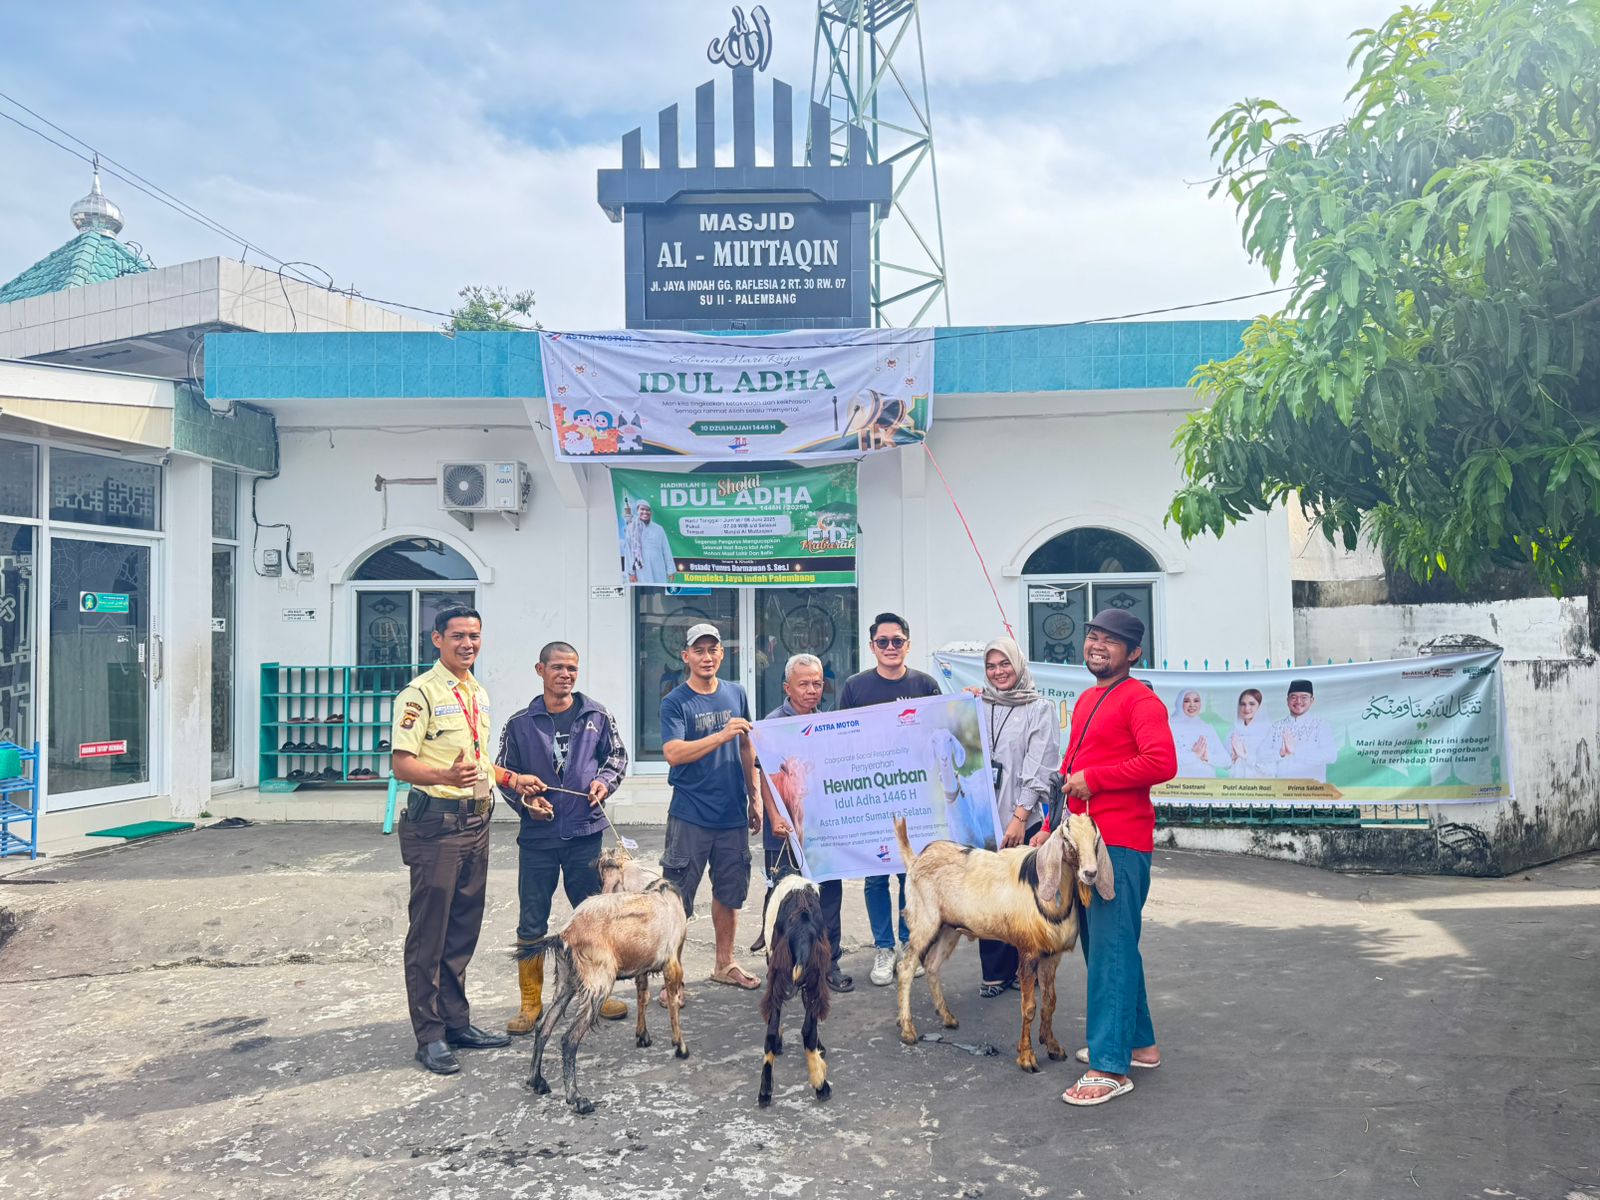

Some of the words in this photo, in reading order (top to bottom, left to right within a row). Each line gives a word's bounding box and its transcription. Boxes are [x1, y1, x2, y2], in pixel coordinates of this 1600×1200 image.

[700, 212, 795, 231] MASJID
[657, 241, 687, 268] AL
[713, 239, 839, 272] MUTTAQIN
[663, 280, 685, 291] JAYA
[688, 280, 715, 291] INDAH
[717, 279, 733, 291] GG.
[735, 279, 778, 290] RAFLESIA
[780, 279, 787, 289] 2
[788, 278, 801, 289] RT.
[804, 278, 814, 289] 30
[817, 278, 833, 289] RW.
[835, 278, 846, 289] 07
[700, 295, 713, 305] SU
[735, 294, 797, 305] PALEMBANG
[638, 372, 723, 394] IDUL
[732, 369, 835, 393] ADHA
[660, 488, 726, 507] IDUL
[734, 486, 813, 506] ADHA
[725, 574, 743, 583] Jaya
[744, 574, 768, 582] Indah
[769, 574, 815, 582] Palembang
[1048, 688, 1075, 698] Raya
[814, 723, 835, 733] ASTRA
[836, 720, 860, 729] MOTOR
[1356, 739, 1375, 747] Mari
[1394, 738, 1423, 747] jadikan
[1425, 737, 1444, 745] Hari
[1460, 735, 1490, 746] sebagai
[1357, 747, 1379, 756] ajang
[1381, 747, 1433, 757] memperkuat
[1435, 745, 1489, 756] pengorbanan
[851, 759, 895, 773] Penyerahan
[1371, 757, 1387, 765] kita
[1388, 756, 1427, 765] terhadap
[1429, 755, 1453, 763] Dinul
[1454, 755, 1477, 763] Islam
[823, 776, 872, 795] Hewan
[873, 768, 927, 789] Qurban
[835, 796, 854, 810] Idul
[856, 793, 881, 807] Adha
[883, 790, 907, 803] 1446
[909, 788, 917, 800] H
[820, 818, 840, 827] Astra
[841, 815, 864, 825] Motor
[903, 806, 932, 817] Selatan
